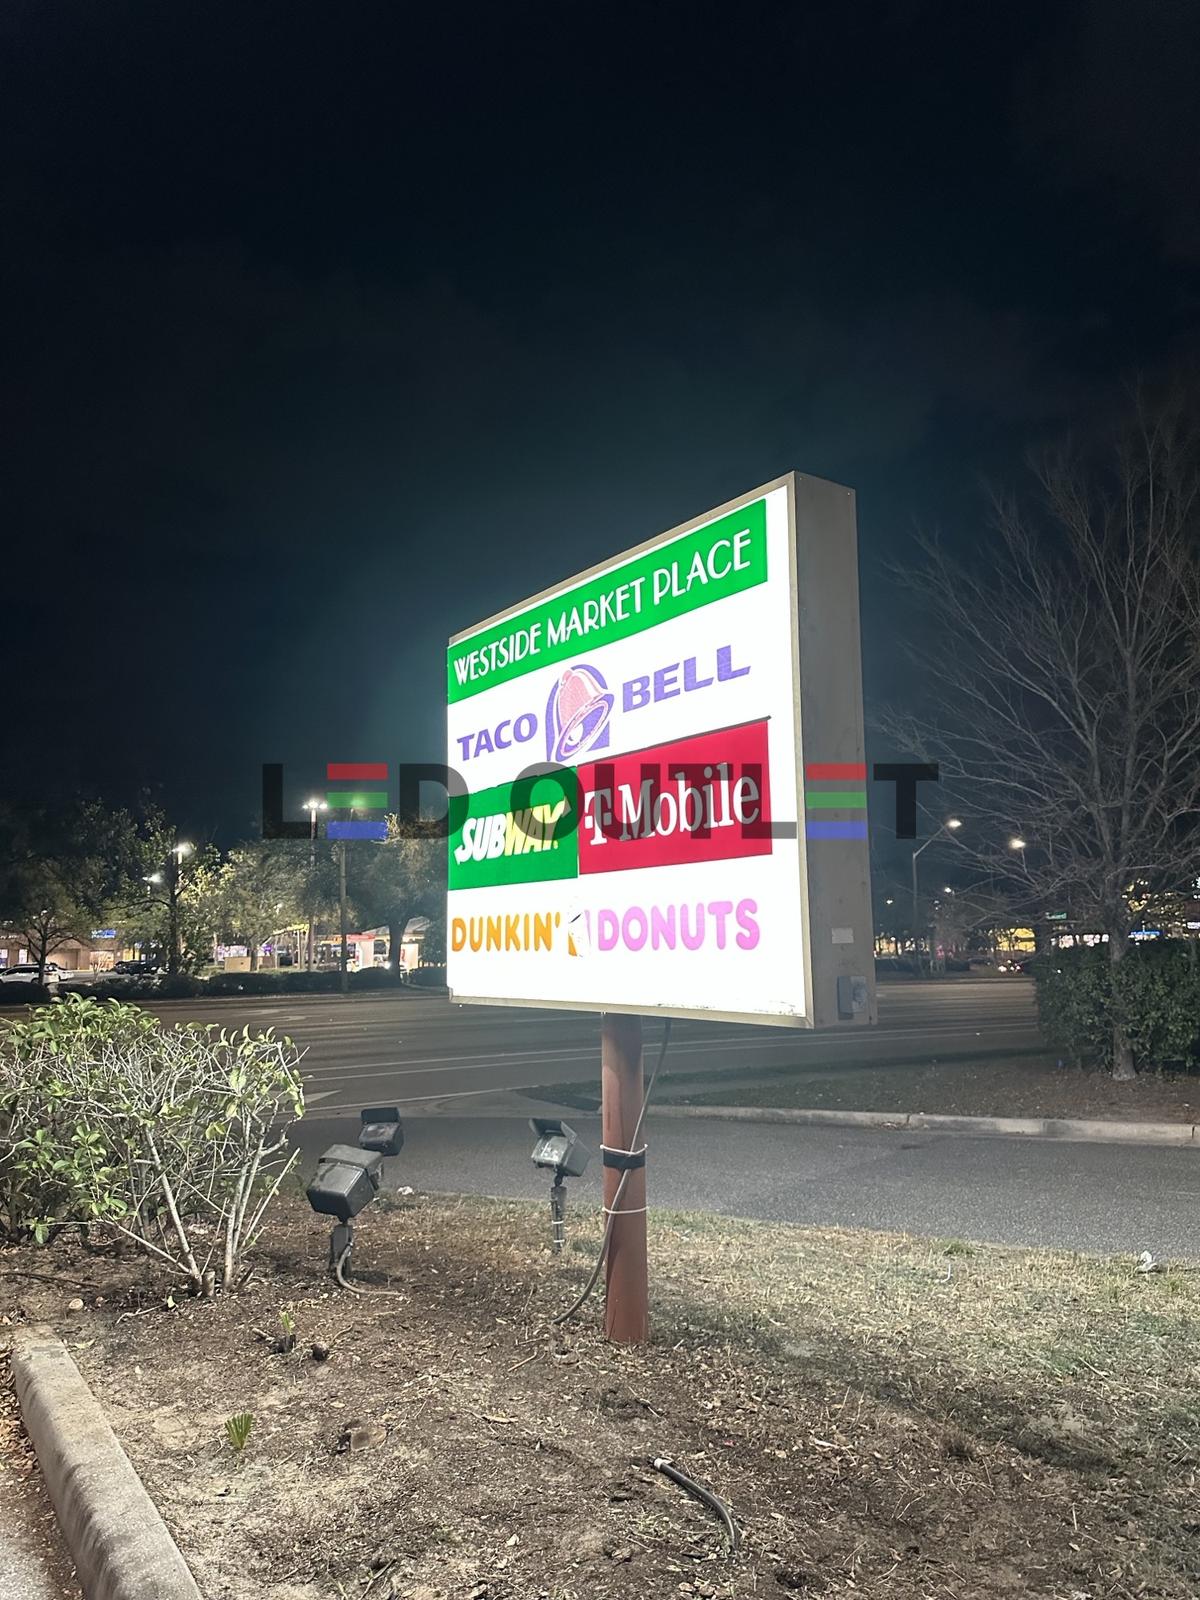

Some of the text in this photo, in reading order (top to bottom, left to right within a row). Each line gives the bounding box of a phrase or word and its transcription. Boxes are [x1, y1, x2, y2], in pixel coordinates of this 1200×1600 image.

[453, 528, 751, 686] WESTSIDE MARKET PLACE
[456, 645, 751, 761] TACO BELL
[453, 795, 572, 865] SUBWAY
[452, 898, 760, 951] DUNKIN' DONUTS
